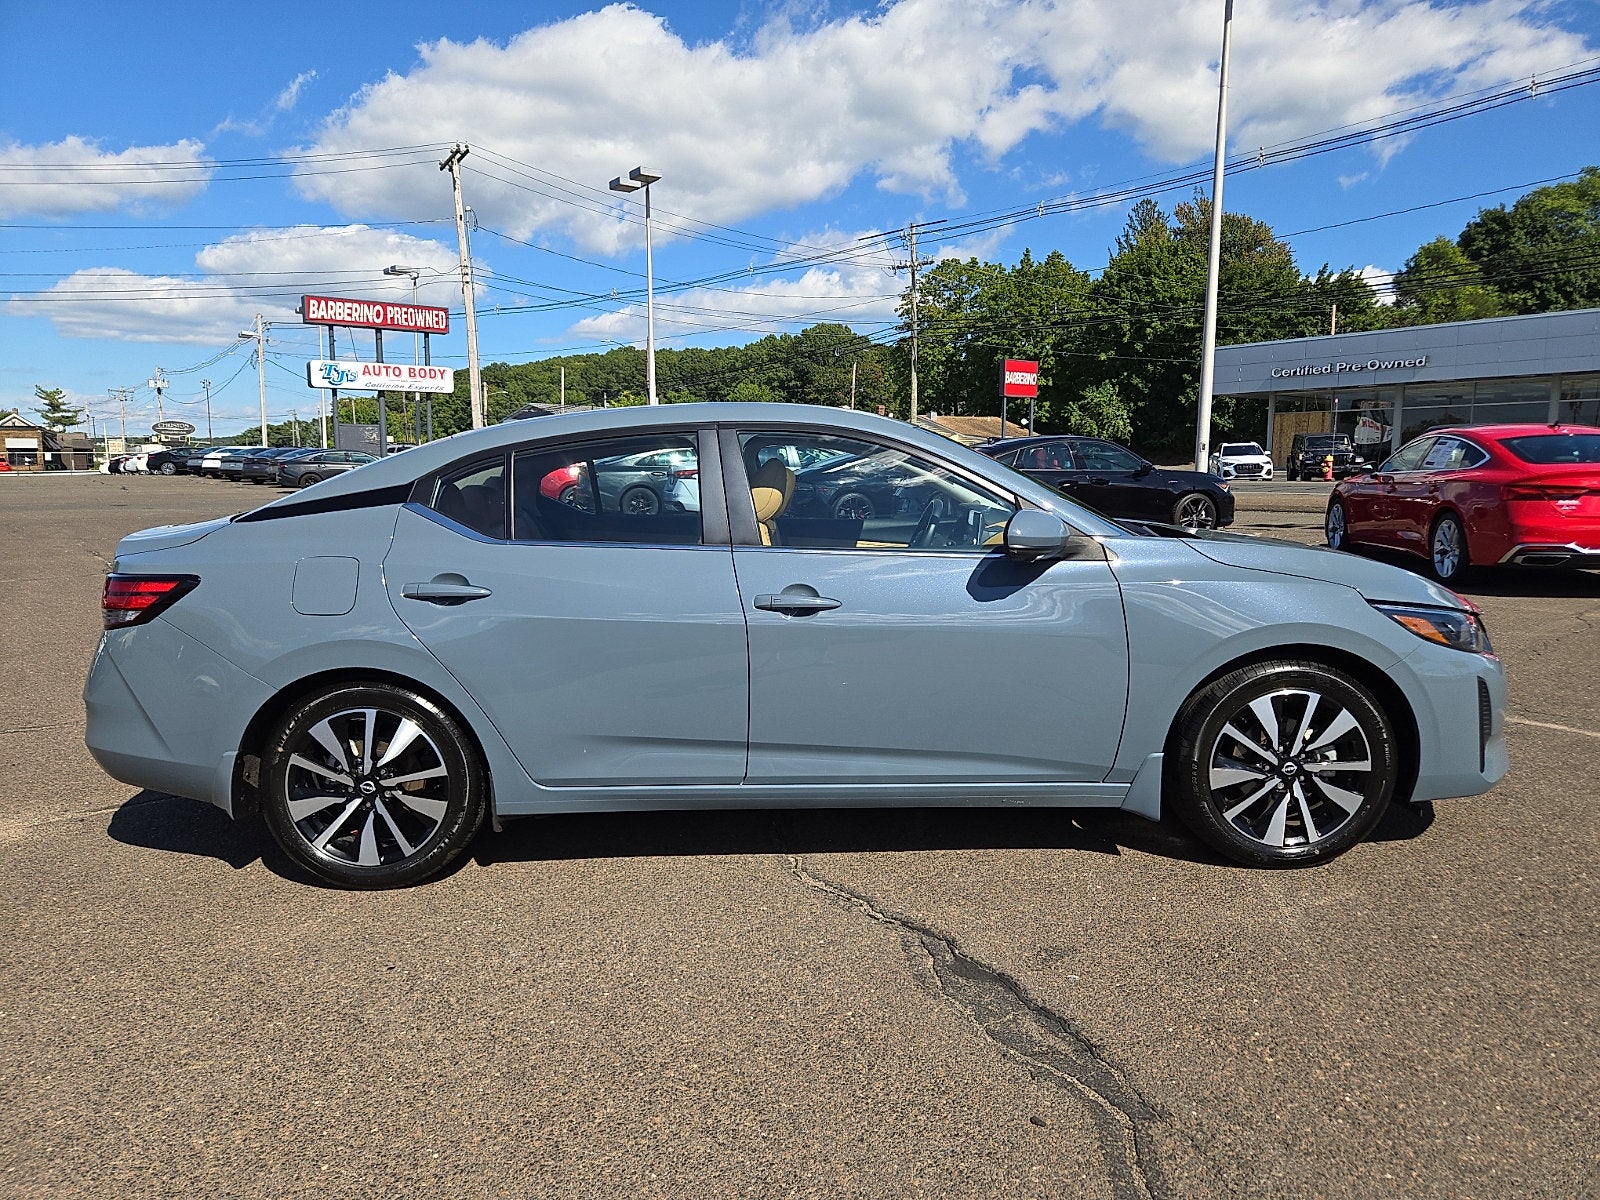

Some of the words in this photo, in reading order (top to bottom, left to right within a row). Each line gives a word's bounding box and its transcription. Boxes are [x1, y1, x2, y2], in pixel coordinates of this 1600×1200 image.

[309, 299, 384, 323] BARBERINO
[386, 305, 446, 329] PREOWNED
[319, 362, 359, 386] TJ's
[362, 364, 402, 378] AUTO
[408, 367, 446, 381] BODY
[1005, 371, 1037, 385] BARBERINO
[1272, 363, 1332, 378] Certified
[1336, 356, 1427, 373] Pre-Owned
[364, 381, 405, 390] Collision
[408, 383, 445, 391] Experts
